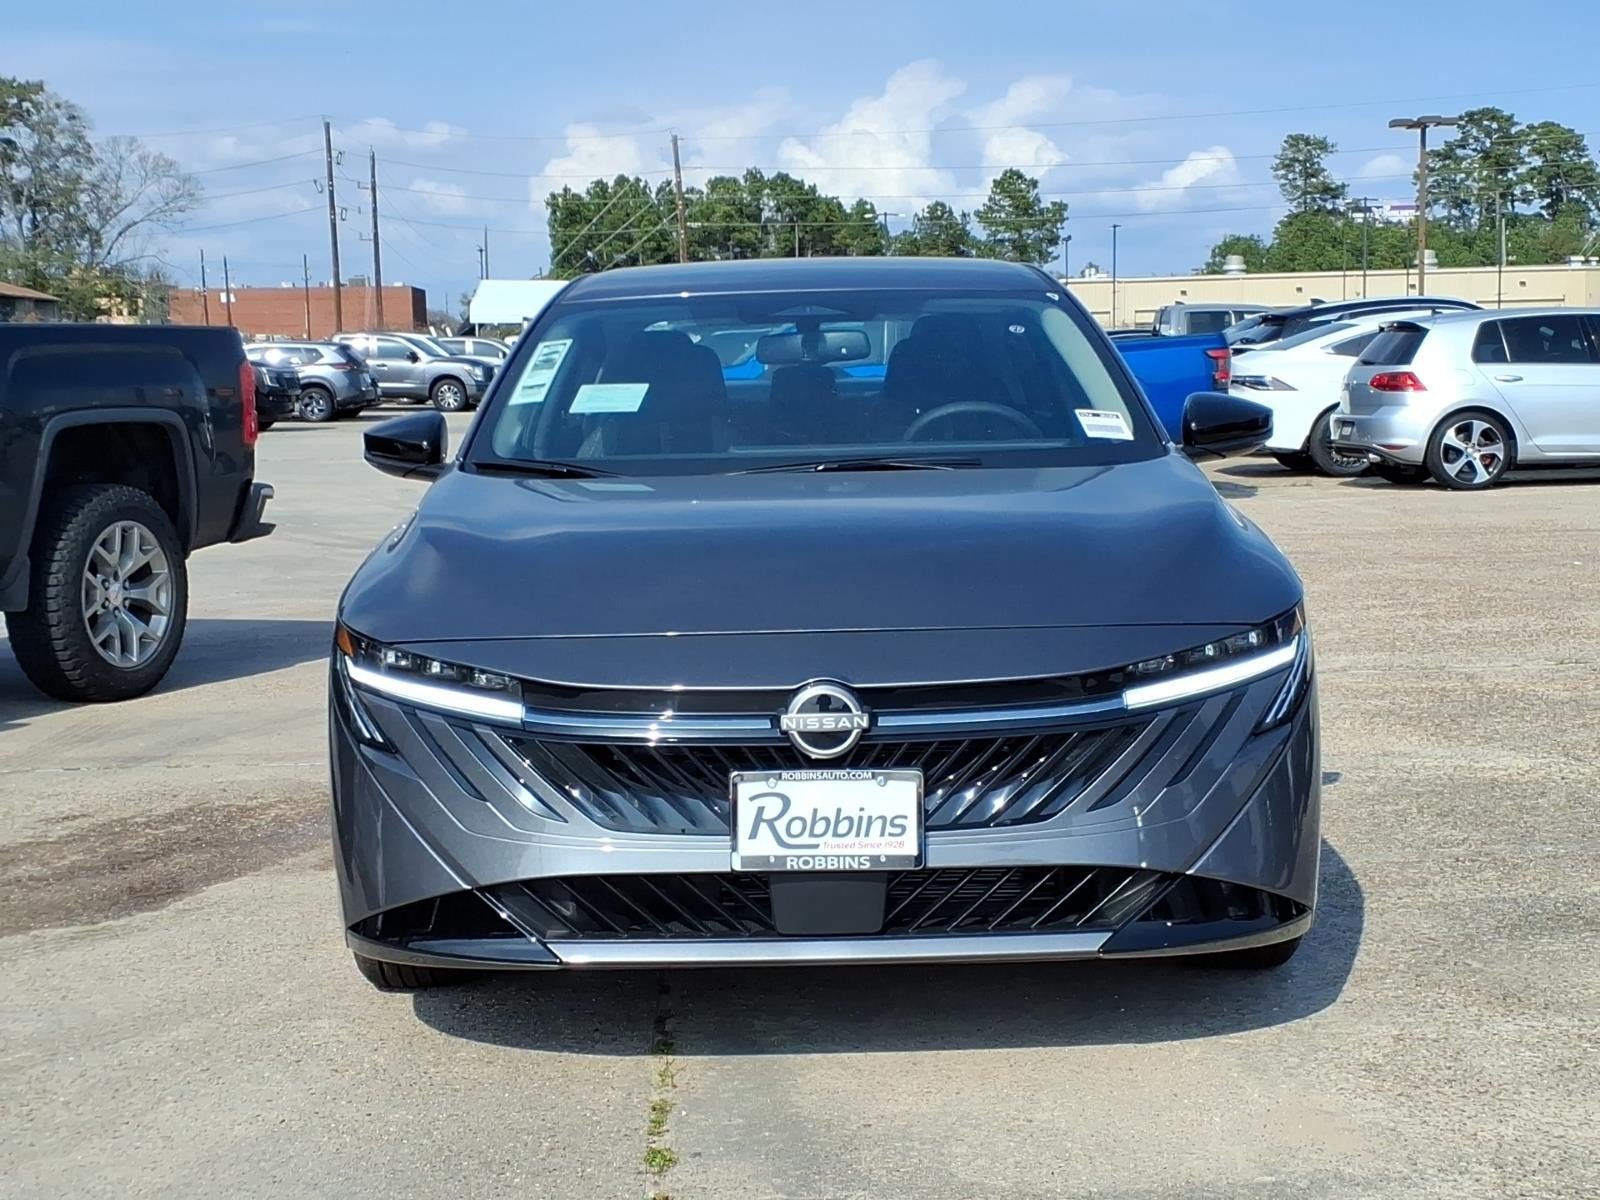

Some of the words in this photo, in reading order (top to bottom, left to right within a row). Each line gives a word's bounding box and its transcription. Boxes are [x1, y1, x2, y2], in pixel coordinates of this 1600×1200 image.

[783, 716, 867, 730] NISSAN
[781, 771, 872, 781] ROBBINSAUTO.COM
[748, 792, 908, 849] Robbins
[823, 841, 856, 850] Trusted
[857, 841, 882, 849] Since
[884, 840, 905, 849] 1928
[786, 856, 871, 869] ROBBINS
